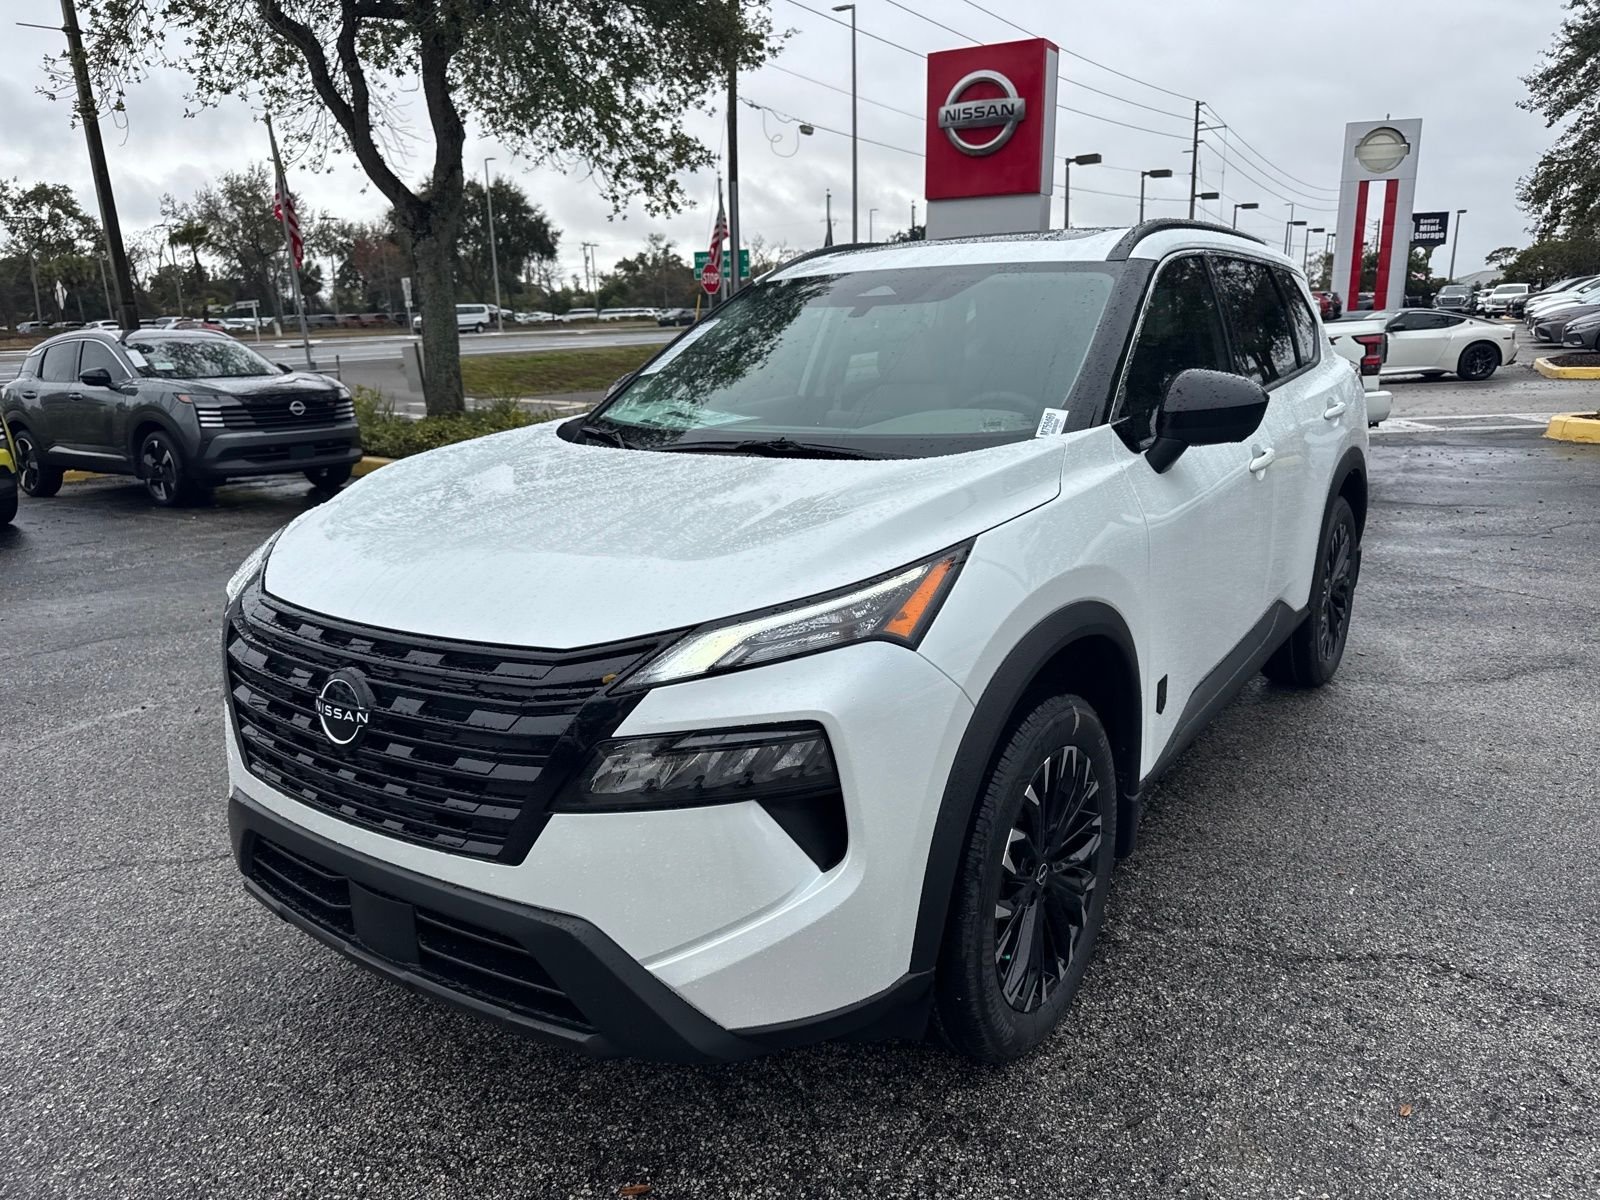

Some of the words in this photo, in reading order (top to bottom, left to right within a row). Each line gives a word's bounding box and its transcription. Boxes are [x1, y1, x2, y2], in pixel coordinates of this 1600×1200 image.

[945, 104, 1014, 122] NISSAN
[702, 273, 720, 284] STOP
[315, 698, 369, 723] NISSAN
